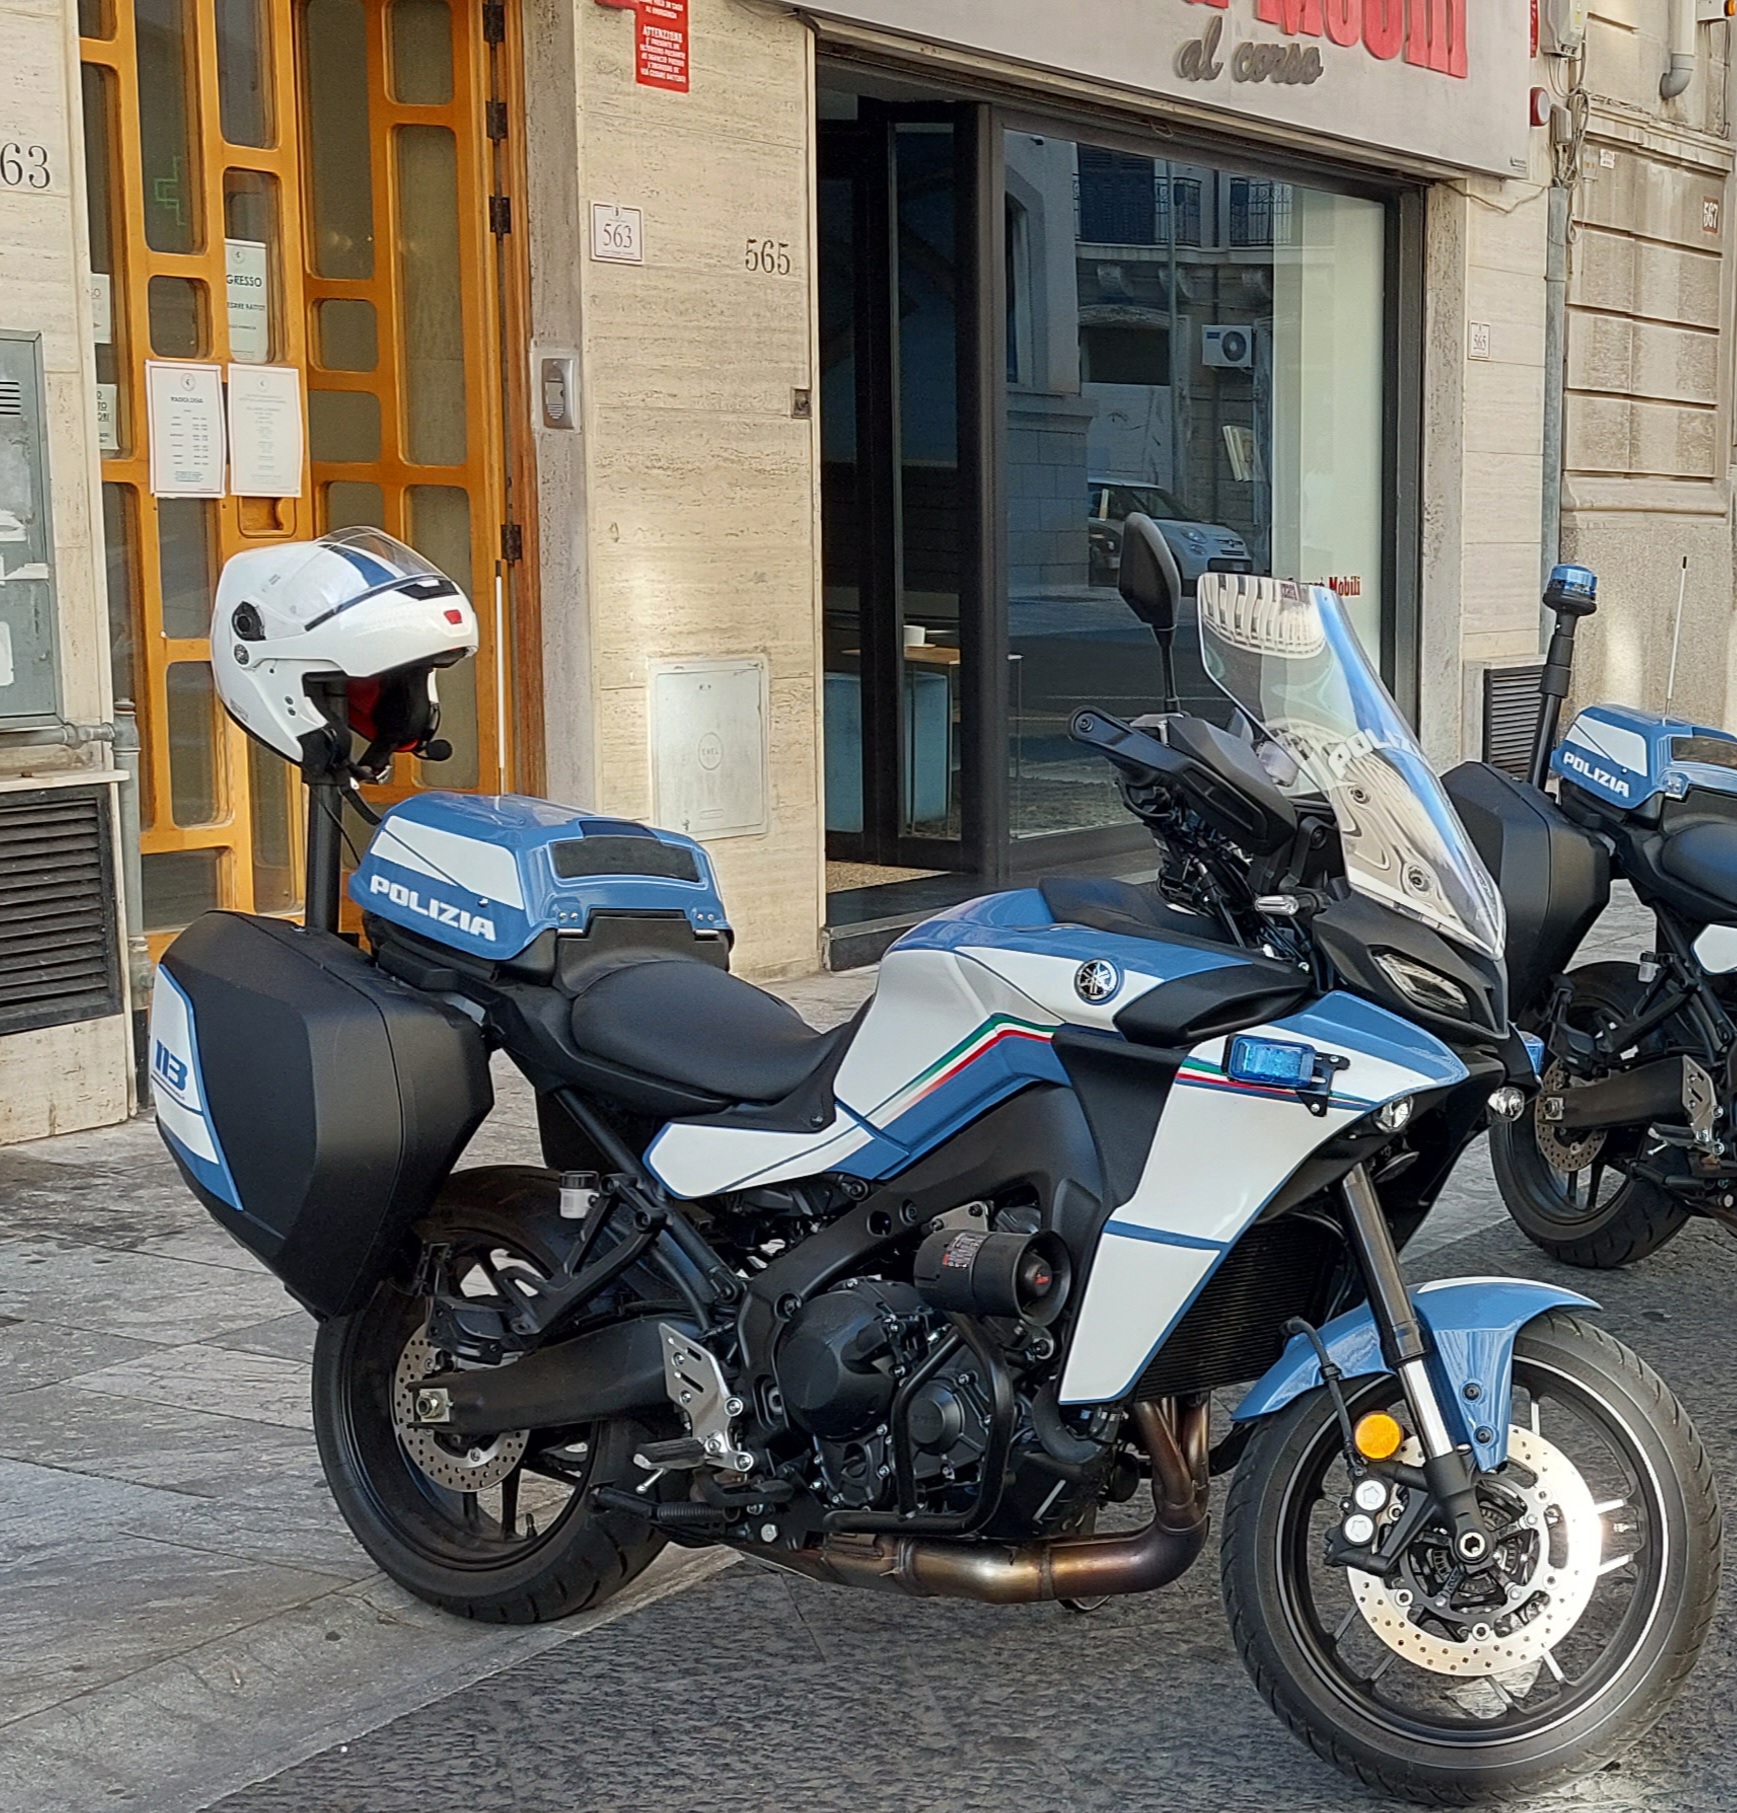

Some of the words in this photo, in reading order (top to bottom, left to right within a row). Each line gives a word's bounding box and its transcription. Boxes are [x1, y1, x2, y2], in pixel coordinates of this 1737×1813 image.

[1175, 15, 1224, 82] al
[1232, 41, 1324, 85] corso
[0, 142, 51, 189] 63
[602, 223, 633, 249] 563
[745, 237, 791, 276] 565
[1328, 575, 1361, 597] Mobili
[1563, 751, 1630, 798] POLIZIA
[370, 874, 497, 942] POLIZIA
[155, 1039, 188, 1092] 113
